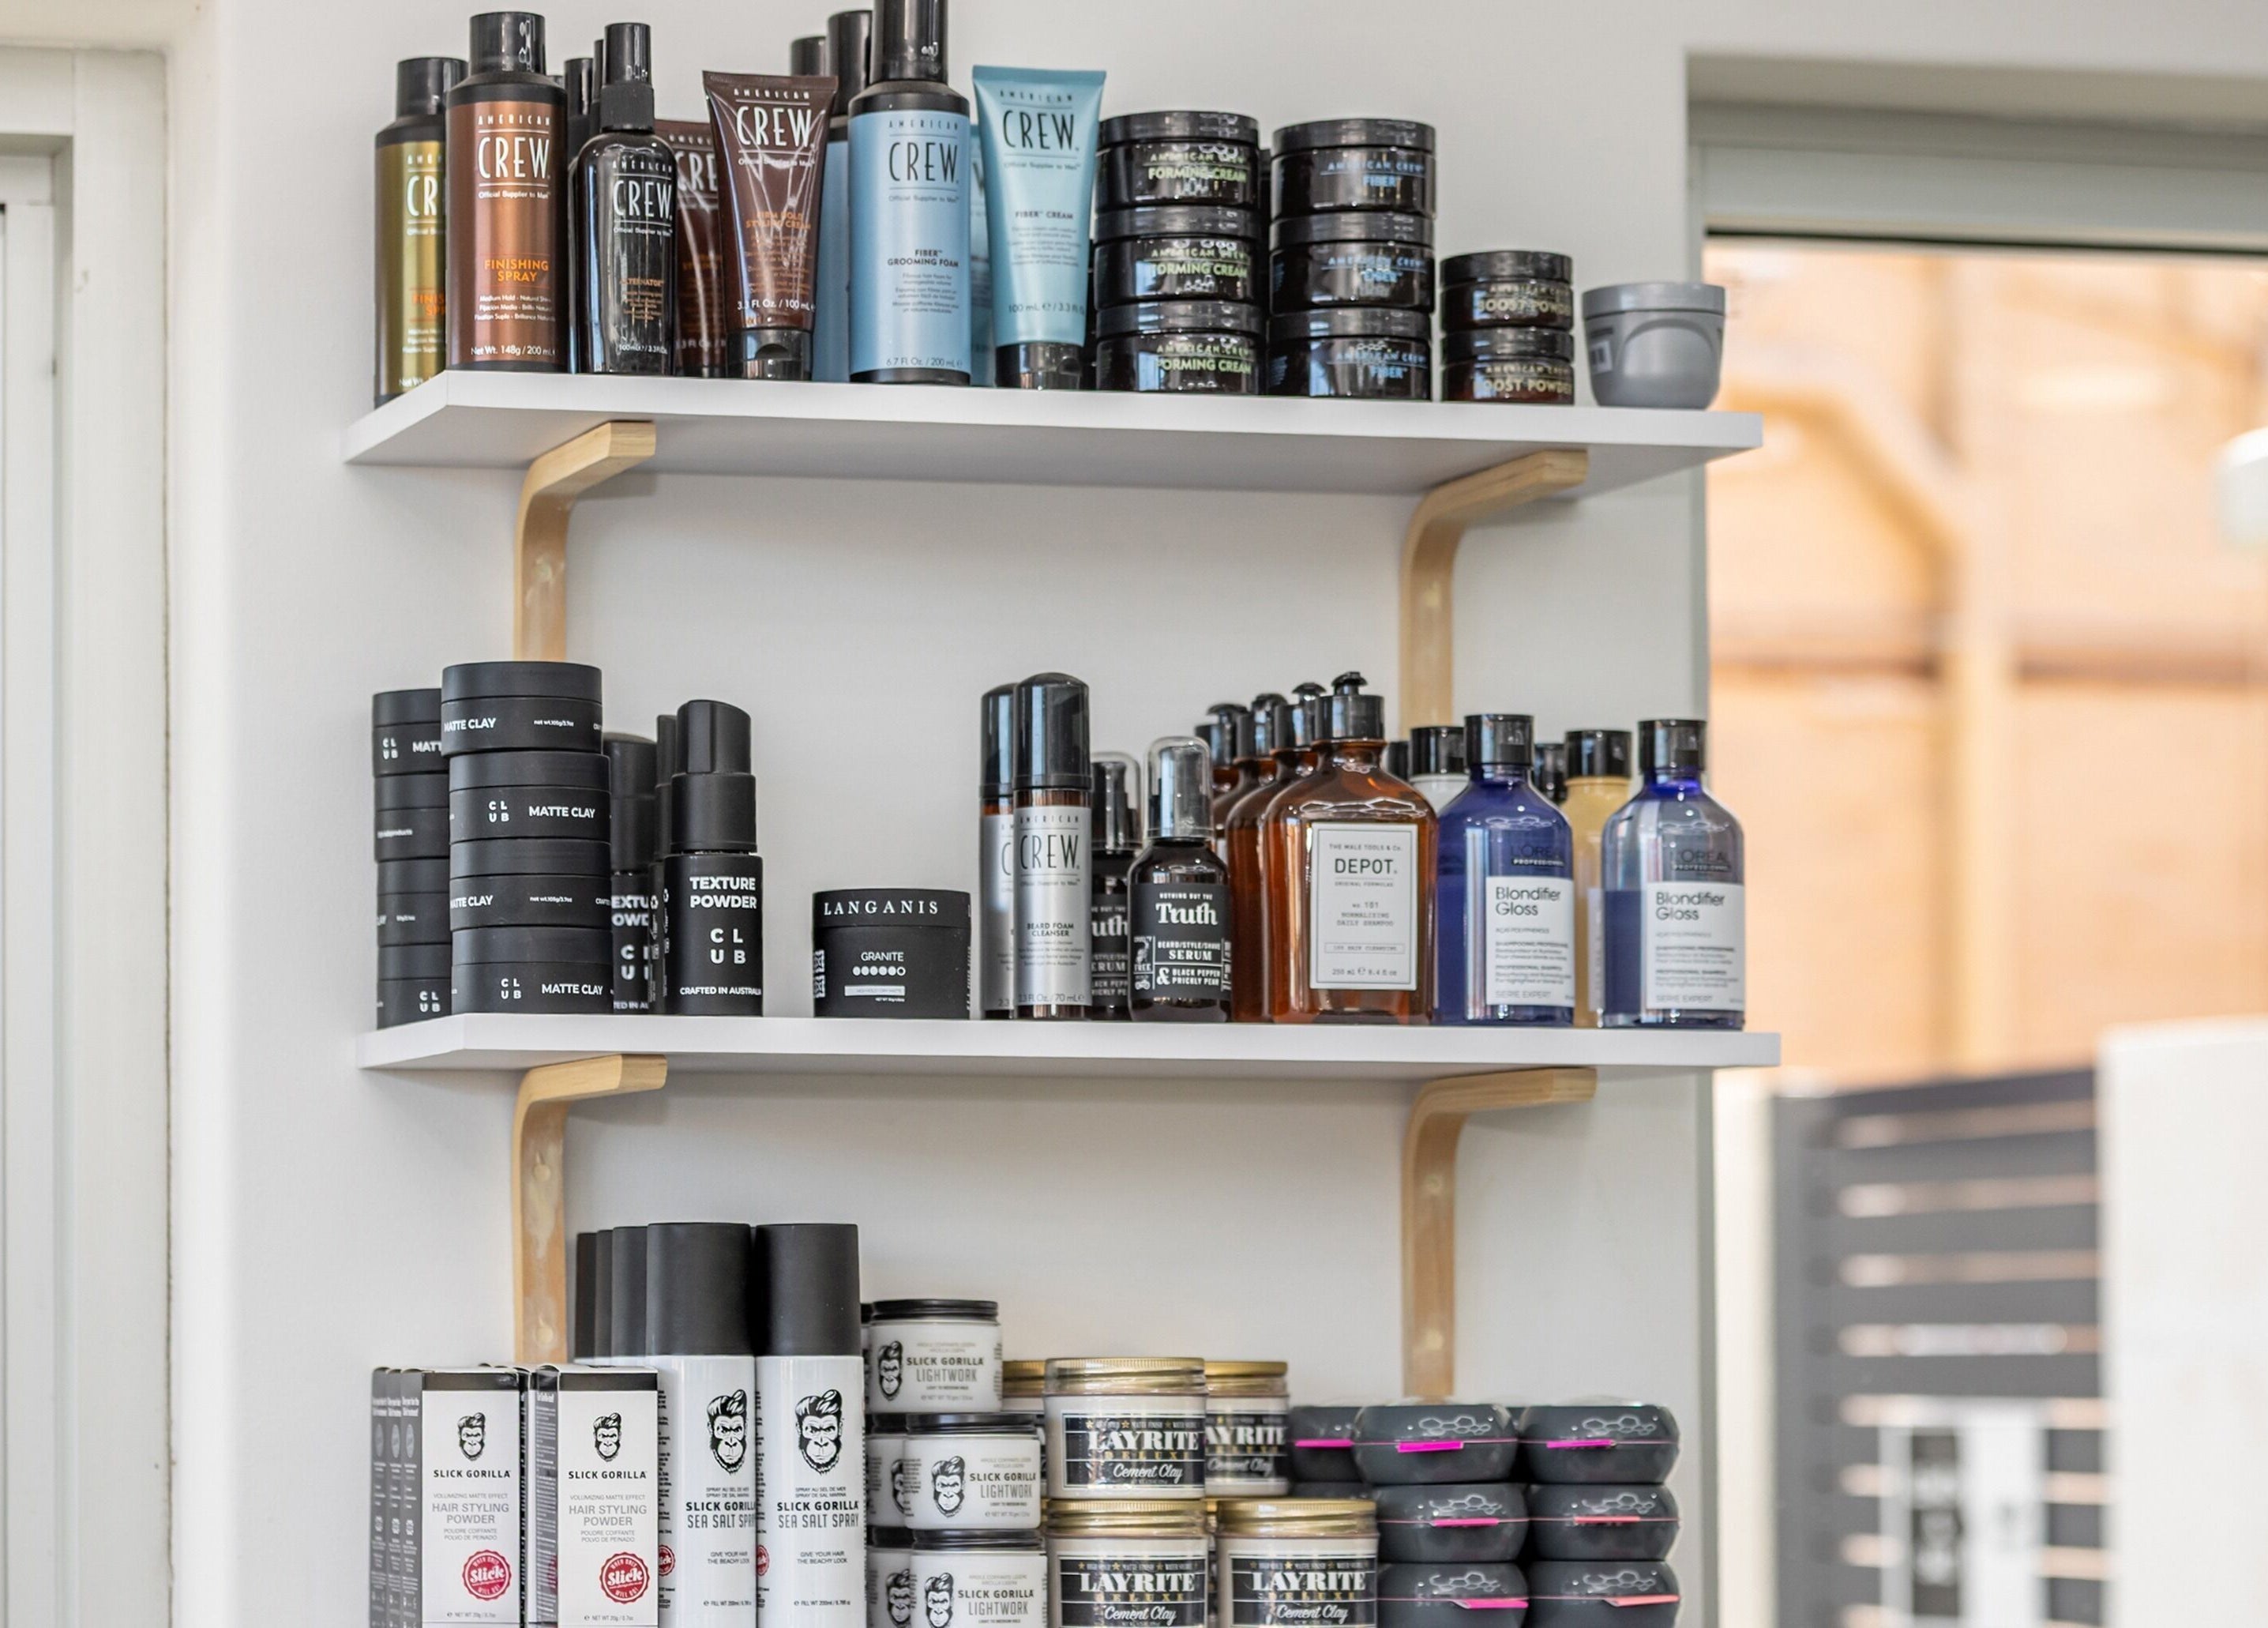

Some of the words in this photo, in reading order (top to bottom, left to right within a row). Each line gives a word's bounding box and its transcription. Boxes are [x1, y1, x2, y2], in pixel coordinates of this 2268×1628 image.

[734, 88, 809, 100] AMERICAN
[478, 115, 550, 126] AMERICAN
[889, 119, 959, 130] AMERICAN
[613, 160, 671, 172] AMERICAN
[485, 260, 549, 271] FINISHING
[887, 258, 937, 267] GROOMING
[939, 258, 959, 268] FOAM
[498, 271, 537, 283] SPRAY
[785, 299, 799, 310] 100
[471, 347, 483, 355] Net
[501, 345, 521, 356] 148g
[527, 345, 542, 355] 200
[444, 720, 467, 732] MATTE
[467, 718, 496, 730] CLAY
[529, 806, 569, 818] MATTE
[571, 806, 596, 819] CLAY
[1019, 814, 1080, 823] AMERICAN
[689, 876, 756, 891] TEXTURE
[1495, 886, 1561, 902] Blondifier
[1655, 892, 1725, 907] Blondifier
[467, 894, 494, 908] CLAY
[689, 894, 757, 908] POWDER
[824, 900, 938, 916] LANGANIS
[1155, 901, 1218, 926] Truth
[1495, 902, 1539, 917] Gloss
[1654, 907, 1700, 921] Gloss
[1027, 922, 1051, 931] BEARD
[1031, 930, 1070, 938] CLEANSER
[861, 952, 904, 962] GRANITE
[1169, 949, 1213, 961] SERUM
[1156, 967, 1170, 986] &
[1172, 968, 1196, 977] BLACK
[1196, 969, 1221, 978] PEPPER
[1172, 977, 1202, 986] PRICKLY
[1203, 978, 1220, 987] PEAR
[542, 983, 580, 995] MATTE
[580, 984, 604, 996] CLAY
[680, 987, 717, 995] CRAFTED
[718, 987, 728, 995] IN
[907, 1357, 937, 1366] SLICK
[941, 1357, 984, 1366] GORILLA
[916, 1368, 978, 1382] LIGHTWORK
[1087, 1431, 1200, 1450] LAYRITE
[434, 1469, 464, 1479] SLICK
[467, 1469, 511, 1479] GORILLA
[568, 1470, 599, 1480] SLICK
[602, 1470, 648, 1480] GORILLA
[969, 1472, 1000, 1482] SLICK
[1113, 1463, 1158, 1479] Cement
[1158, 1463, 1183, 1483] Clay
[980, 1484, 1033, 1498] LIGHTWORK
[432, 1502, 460, 1513] HAIR
[461, 1502, 510, 1513] STYLING
[569, 1504, 596, 1515] HAIR
[599, 1504, 648, 1515] STYLING
[686, 1502, 721, 1512] SLICK
[777, 1502, 810, 1512] SLICK
[814, 1501, 859, 1512] GORILLA
[446, 1514, 495, 1524] POWDER
[583, 1516, 633, 1526] POWDER
[687, 1513, 710, 1528] SEA
[712, 1513, 736, 1528] SALT
[778, 1513, 798, 1528] SEA
[802, 1513, 828, 1528] SALT
[832, 1513, 859, 1528] SPRAY
[470, 1564, 505, 1584] Slick
[607, 1567, 644, 1586] Slick
[1080, 1573, 1196, 1592] LAYRITE
[1252, 1571, 1367, 1591] LAYRITE
[958, 1589, 989, 1599] SLICK
[993, 1589, 1034, 1599] GORILLA
[1094, 1592, 1184, 1602] DELUXE
[968, 1601, 1028, 1615] LIGHTWORK
[1105, 1606, 1150, 1620] Cement
[1150, 1606, 1177, 1626] Clay
[1276, 1604, 1321, 1619] Cement
[1322, 1604, 1349, 1625] Clay
